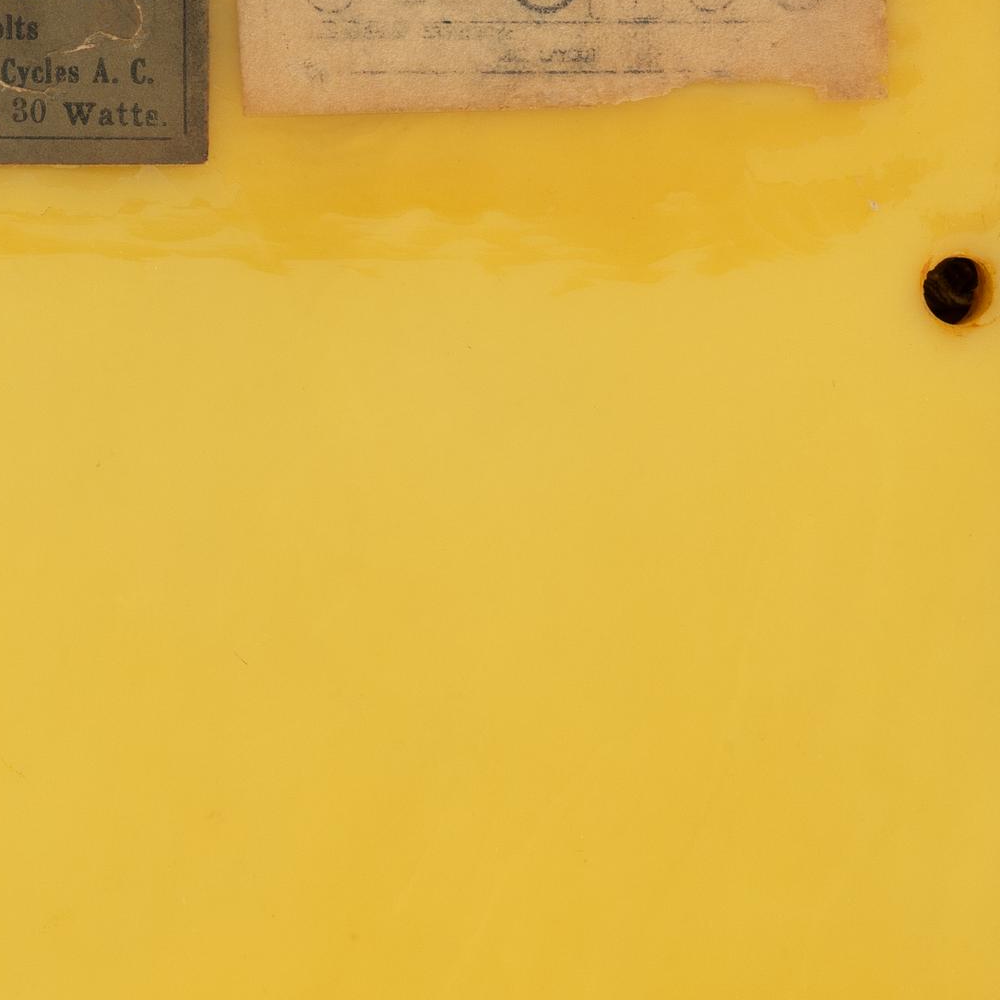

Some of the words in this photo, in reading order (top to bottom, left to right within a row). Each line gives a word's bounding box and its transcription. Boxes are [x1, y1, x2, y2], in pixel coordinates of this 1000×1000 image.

[2, 57, 80, 88] Cycles
[93, 57, 119, 84] A.
[132, 58, 155, 84] C.
[13, 98, 47, 123] 30
